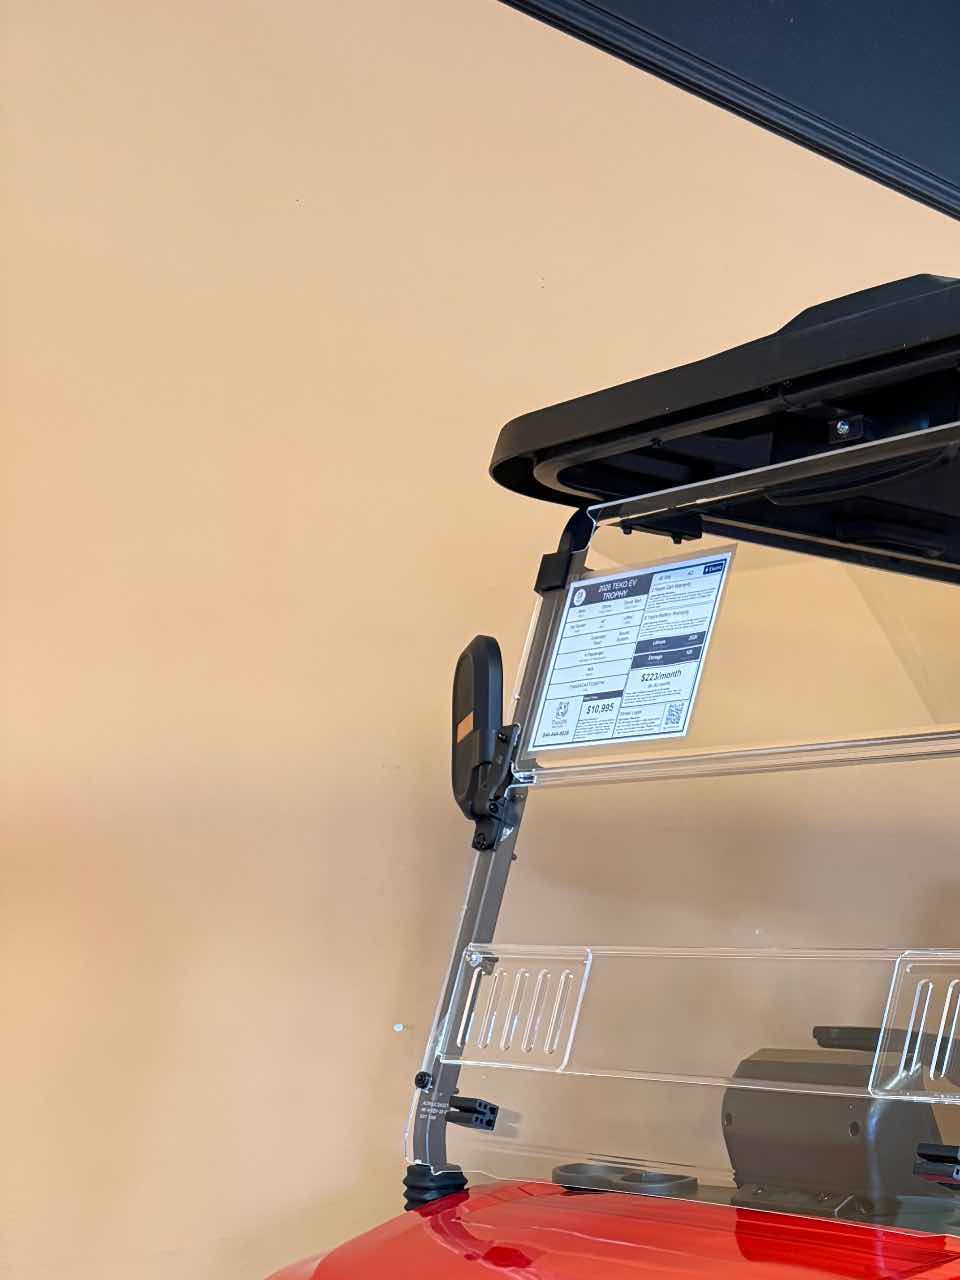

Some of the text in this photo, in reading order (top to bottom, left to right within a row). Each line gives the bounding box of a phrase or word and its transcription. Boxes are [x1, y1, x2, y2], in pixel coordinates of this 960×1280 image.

[612, 580, 628, 590] TEKO
[628, 578, 638, 587] EV
[602, 589, 629, 600] TROPHY
[641, 670, 682, 682] $223/month
[586, 702, 615, 715] $10,995
